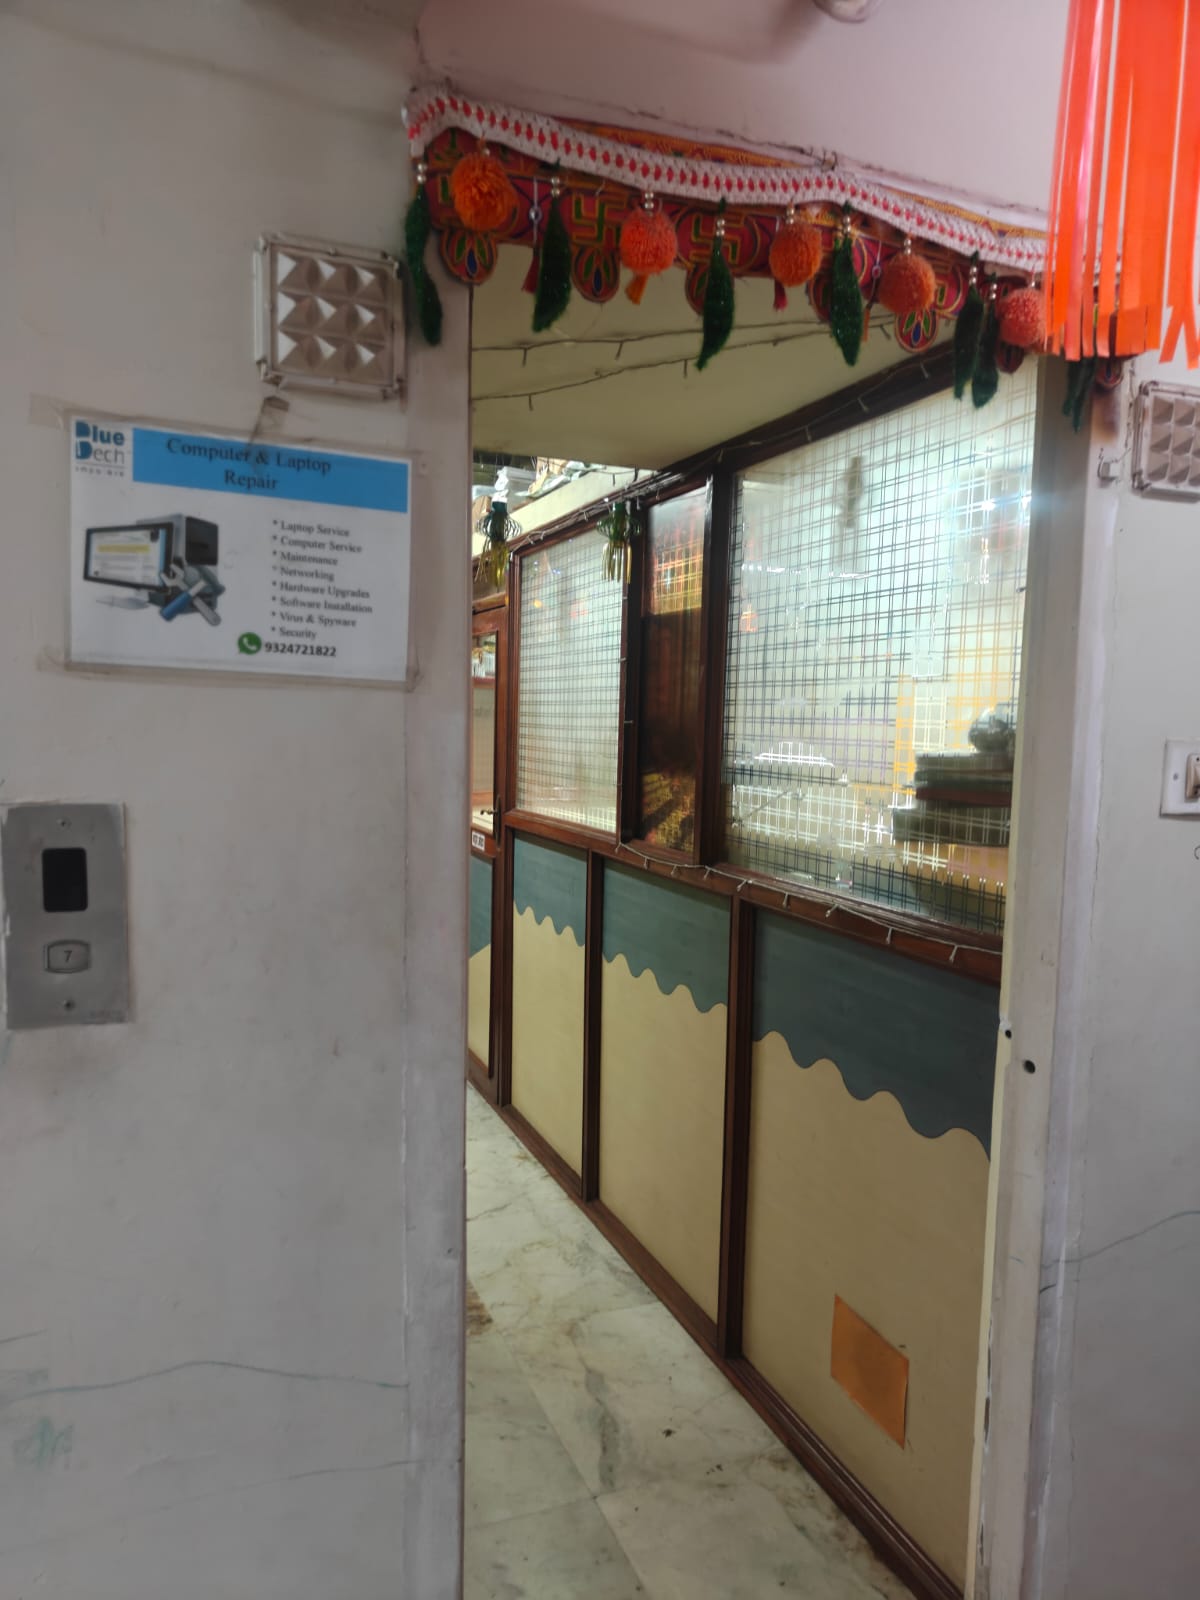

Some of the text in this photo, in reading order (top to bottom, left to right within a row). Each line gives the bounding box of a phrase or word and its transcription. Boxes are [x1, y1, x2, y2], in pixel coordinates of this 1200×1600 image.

[75, 420, 125, 447] Blue
[166, 437, 332, 477] Computer & Laptop
[224, 469, 278, 490] Repair
[281, 519, 350, 537] Laptop Service
[280, 535, 363, 553] Computer Service
[280, 551, 339, 566] Maintenance
[280, 566, 335, 582] Networking
[280, 581, 371, 599] Hardware Upgrades
[280, 596, 373, 614] Software Installation
[305, 614, 314, 624] &
[318, 614, 357, 628] Spyware
[279, 626, 317, 641] Security
[264, 641, 337, 658] 9324721822
[64, 950, 72, 963] 7
